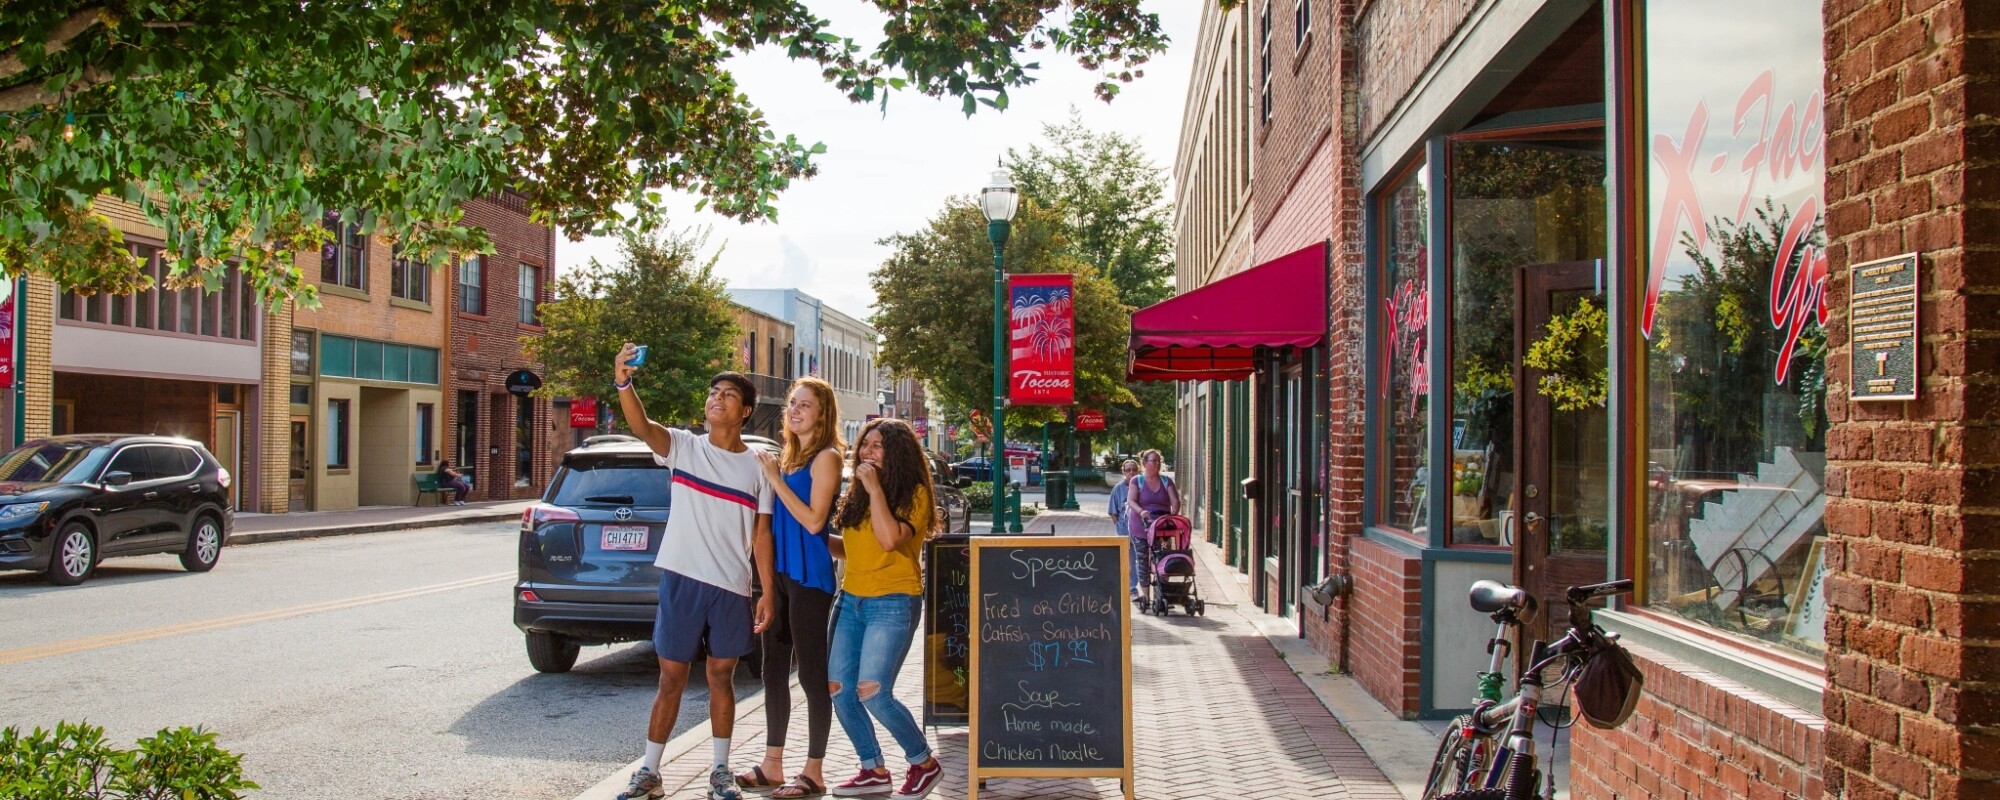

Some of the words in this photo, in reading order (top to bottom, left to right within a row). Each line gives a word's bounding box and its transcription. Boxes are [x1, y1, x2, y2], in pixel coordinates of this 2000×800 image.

[1013, 369, 1071, 389] Toccoa
[1009, 549, 1098, 588] Special
[983, 592, 1020, 620] Fried
[1058, 592, 1113, 615] Grilled
[981, 622, 1030, 643] Catfish
[1042, 620, 1112, 641] Sandwich
[1026, 640, 1092, 671] $7.99
[1017, 680, 1060, 708] Soup
[1003, 711, 1042, 732] Home
[1050, 718, 1096, 735] made
[983, 740, 1043, 761] Chicken
